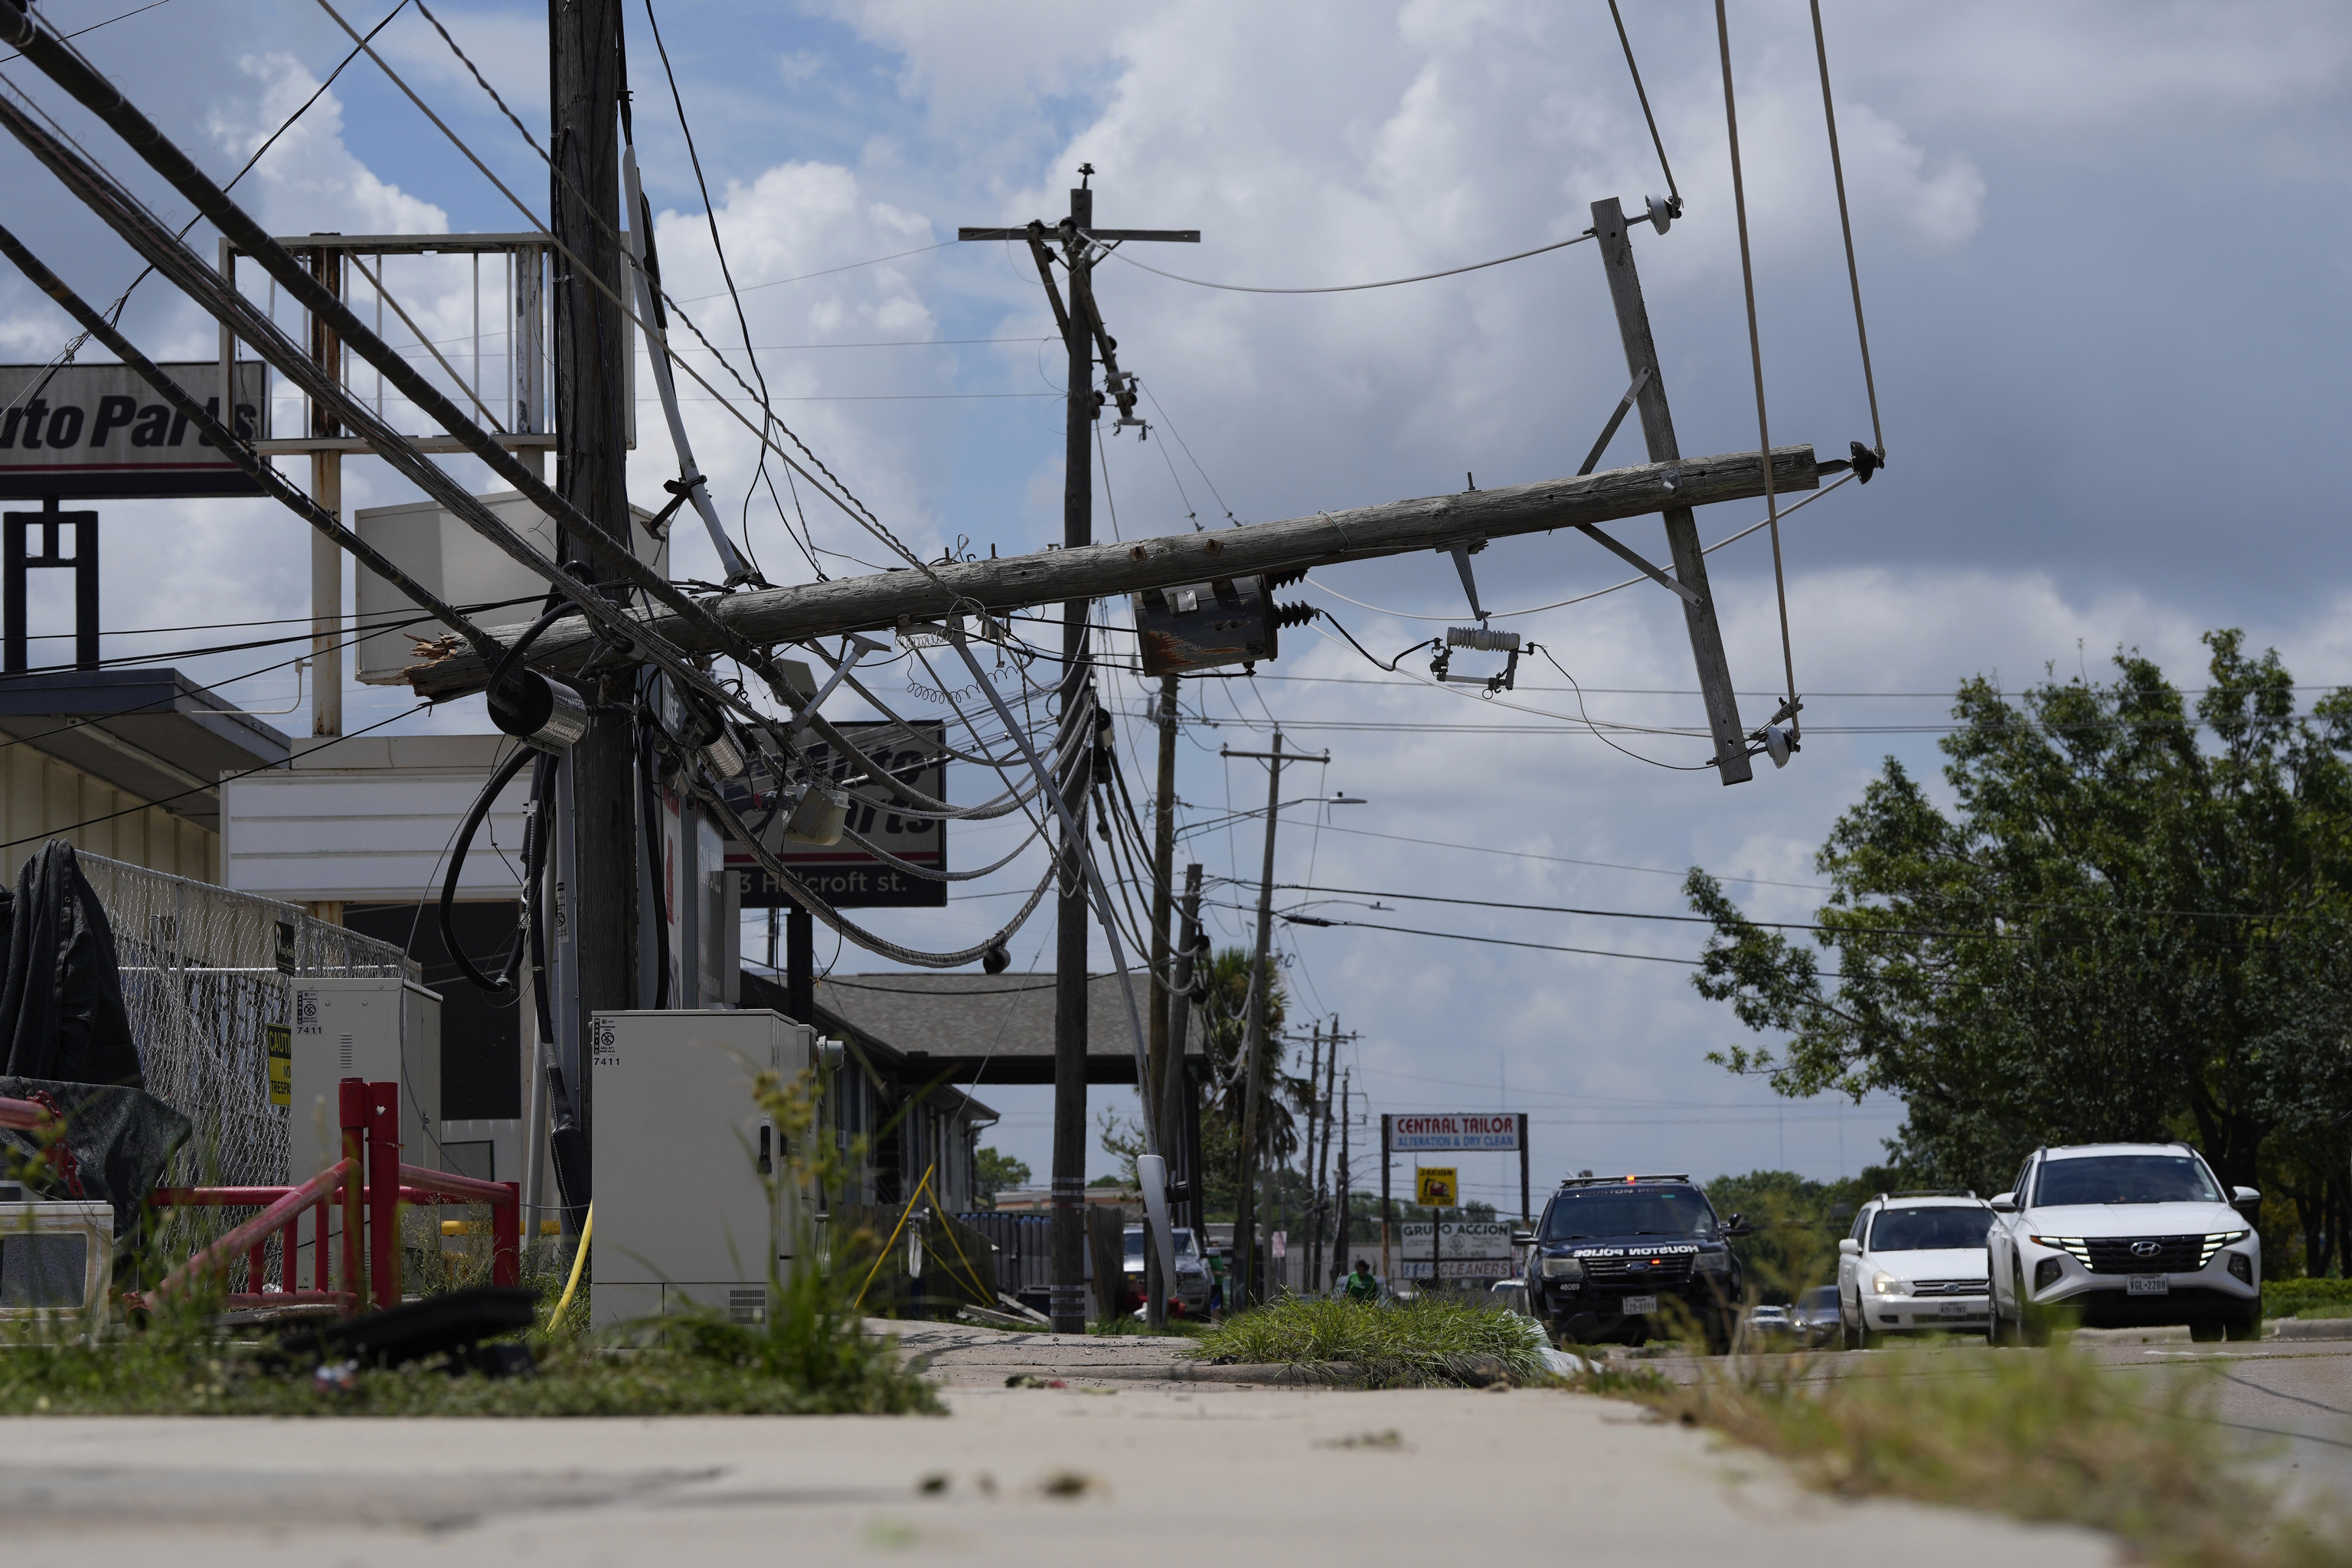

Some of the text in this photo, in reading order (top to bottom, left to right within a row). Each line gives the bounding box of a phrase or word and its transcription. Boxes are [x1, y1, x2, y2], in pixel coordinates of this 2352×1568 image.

[763, 871, 868, 893] Hlcroft
[270, 1031, 292, 1054] CAUTI
[593, 1057, 619, 1066] 7411
[270, 1080, 292, 1094] TRESPA
[1397, 1117, 1514, 1134] CENTRAL TAILOR
[1398, 1136, 1451, 1147] ALTERATION
[1484, 1135, 1514, 1146] CLEAN
[1403, 1224, 1508, 1236] GRUO ACCION
[1441, 1262, 1508, 1277] CLEANERS
